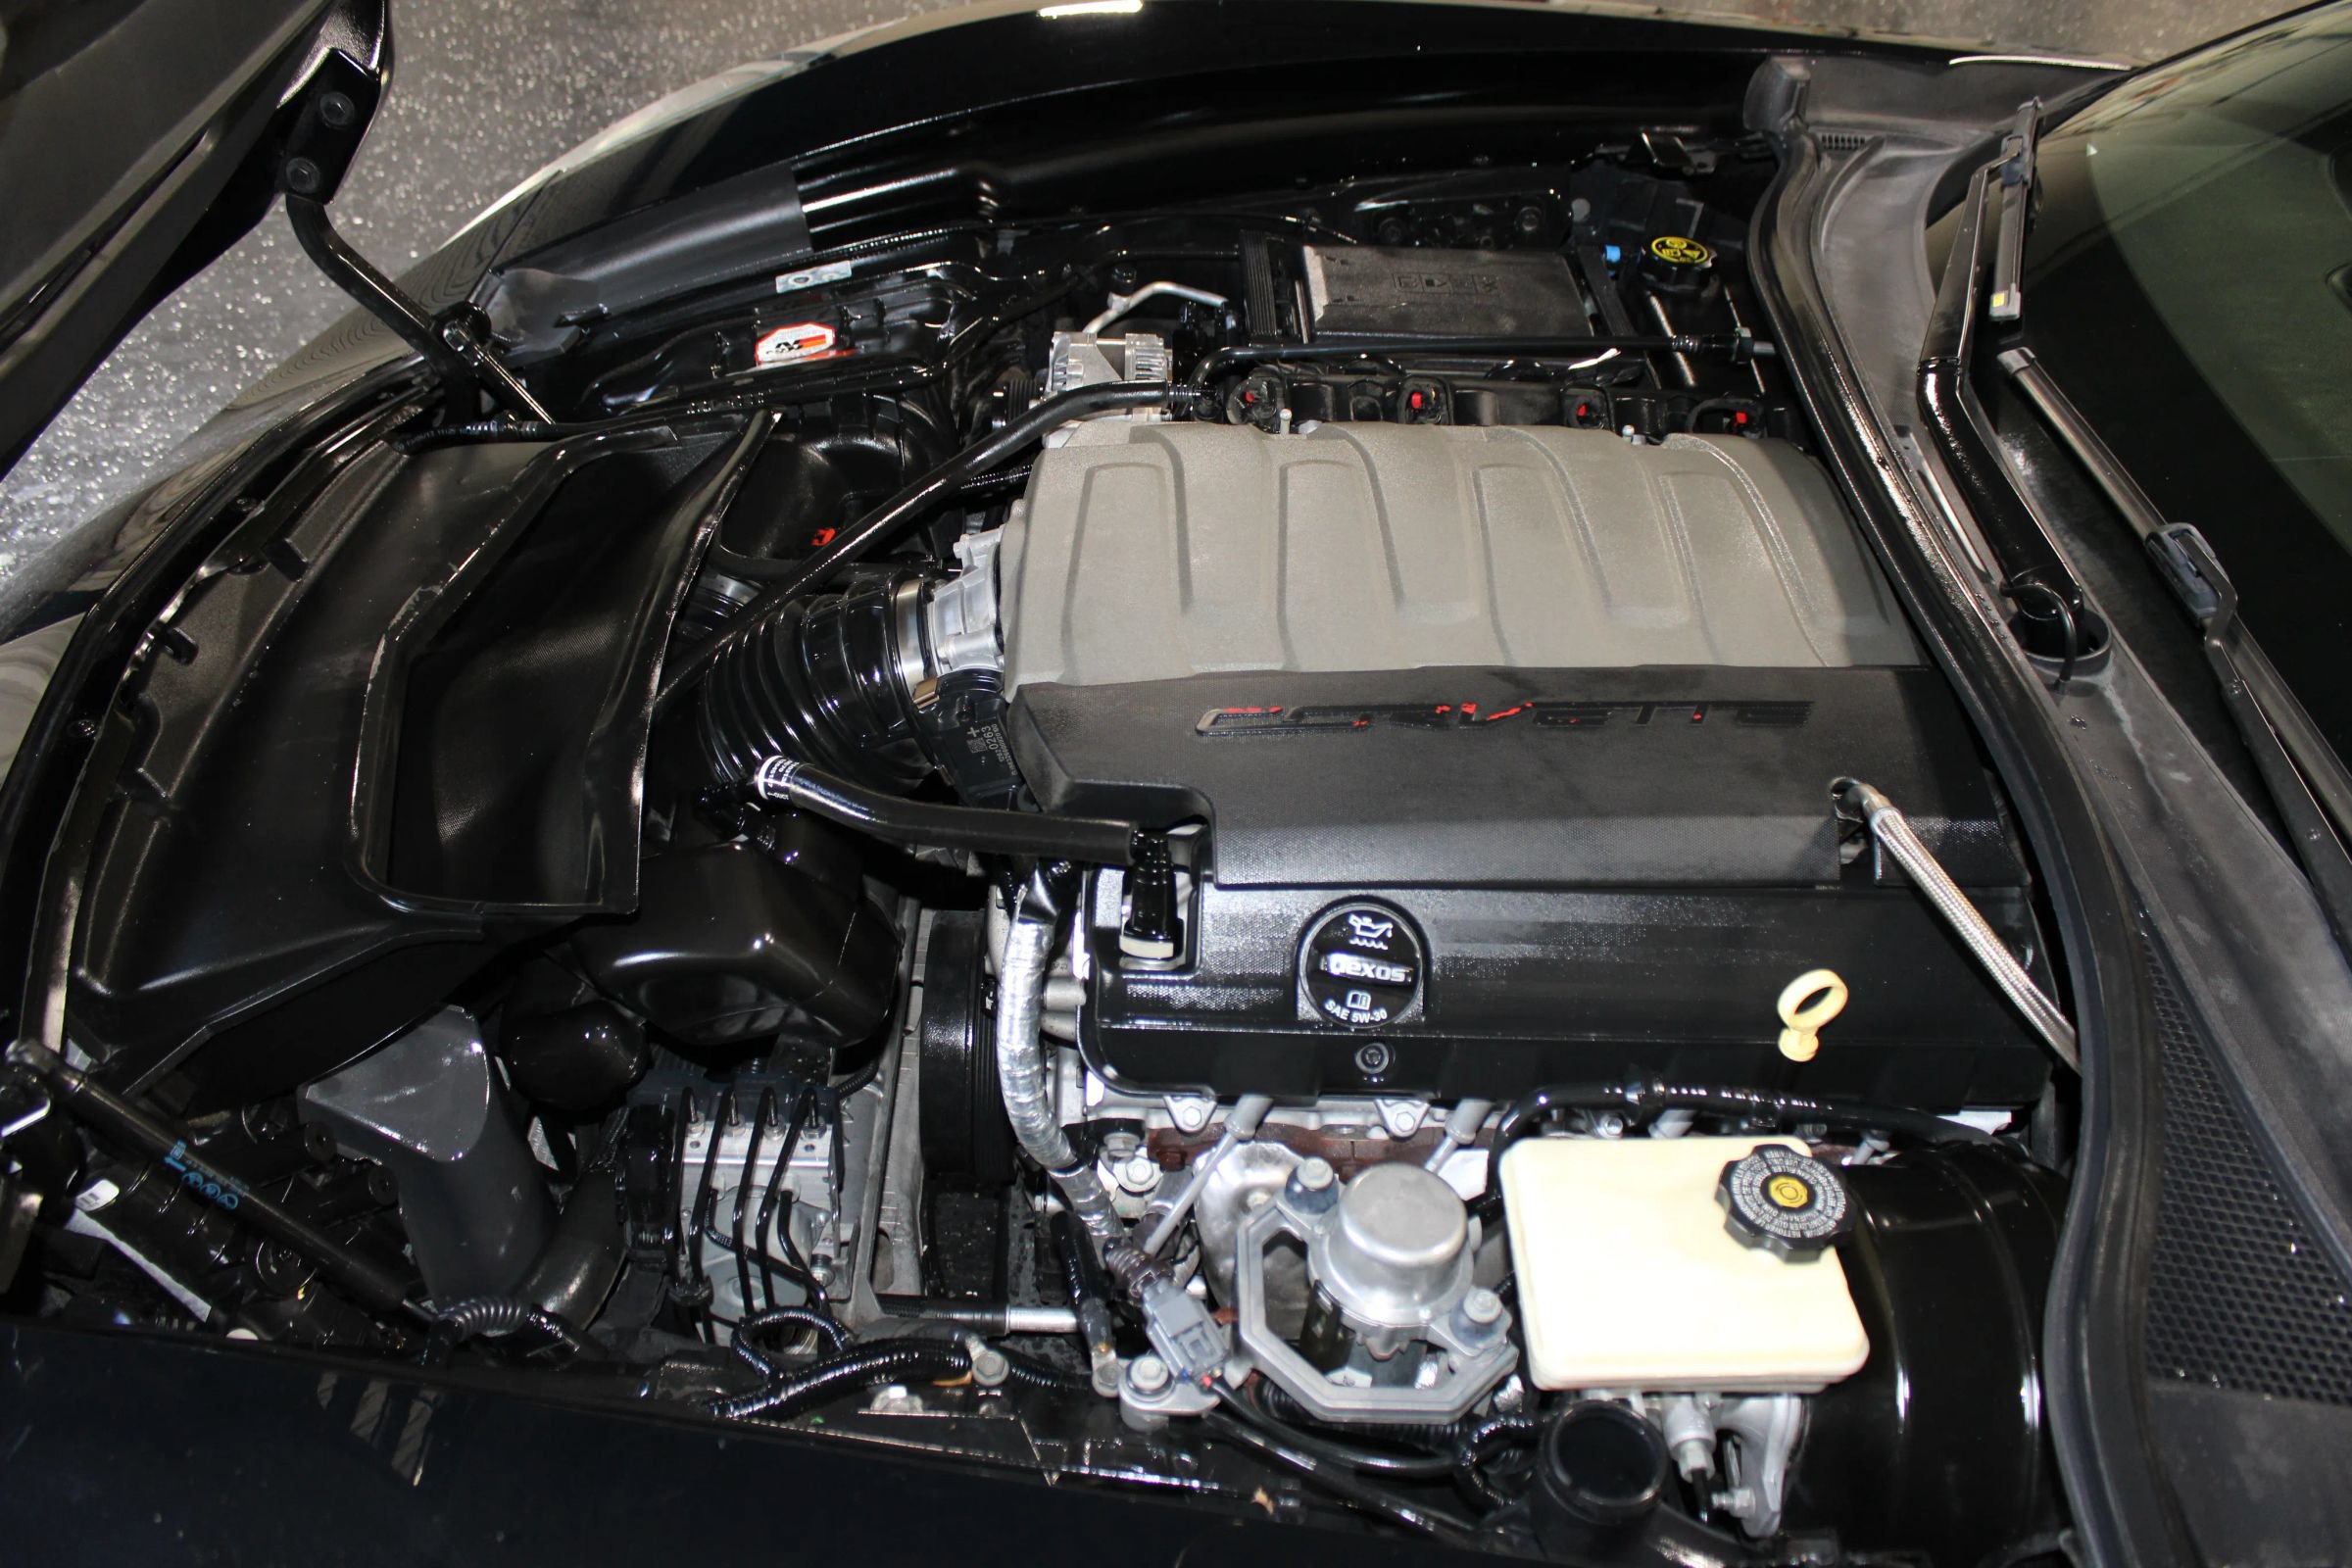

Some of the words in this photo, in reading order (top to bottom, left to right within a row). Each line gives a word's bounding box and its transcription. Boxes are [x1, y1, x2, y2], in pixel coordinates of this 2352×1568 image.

[1195, 701, 1816, 735] CORVETTE
[981, 725, 1000, 751] 0263
[1324, 1000, 1350, 1021] SAE
[1351, 1007, 1389, 1023] 5W-30
